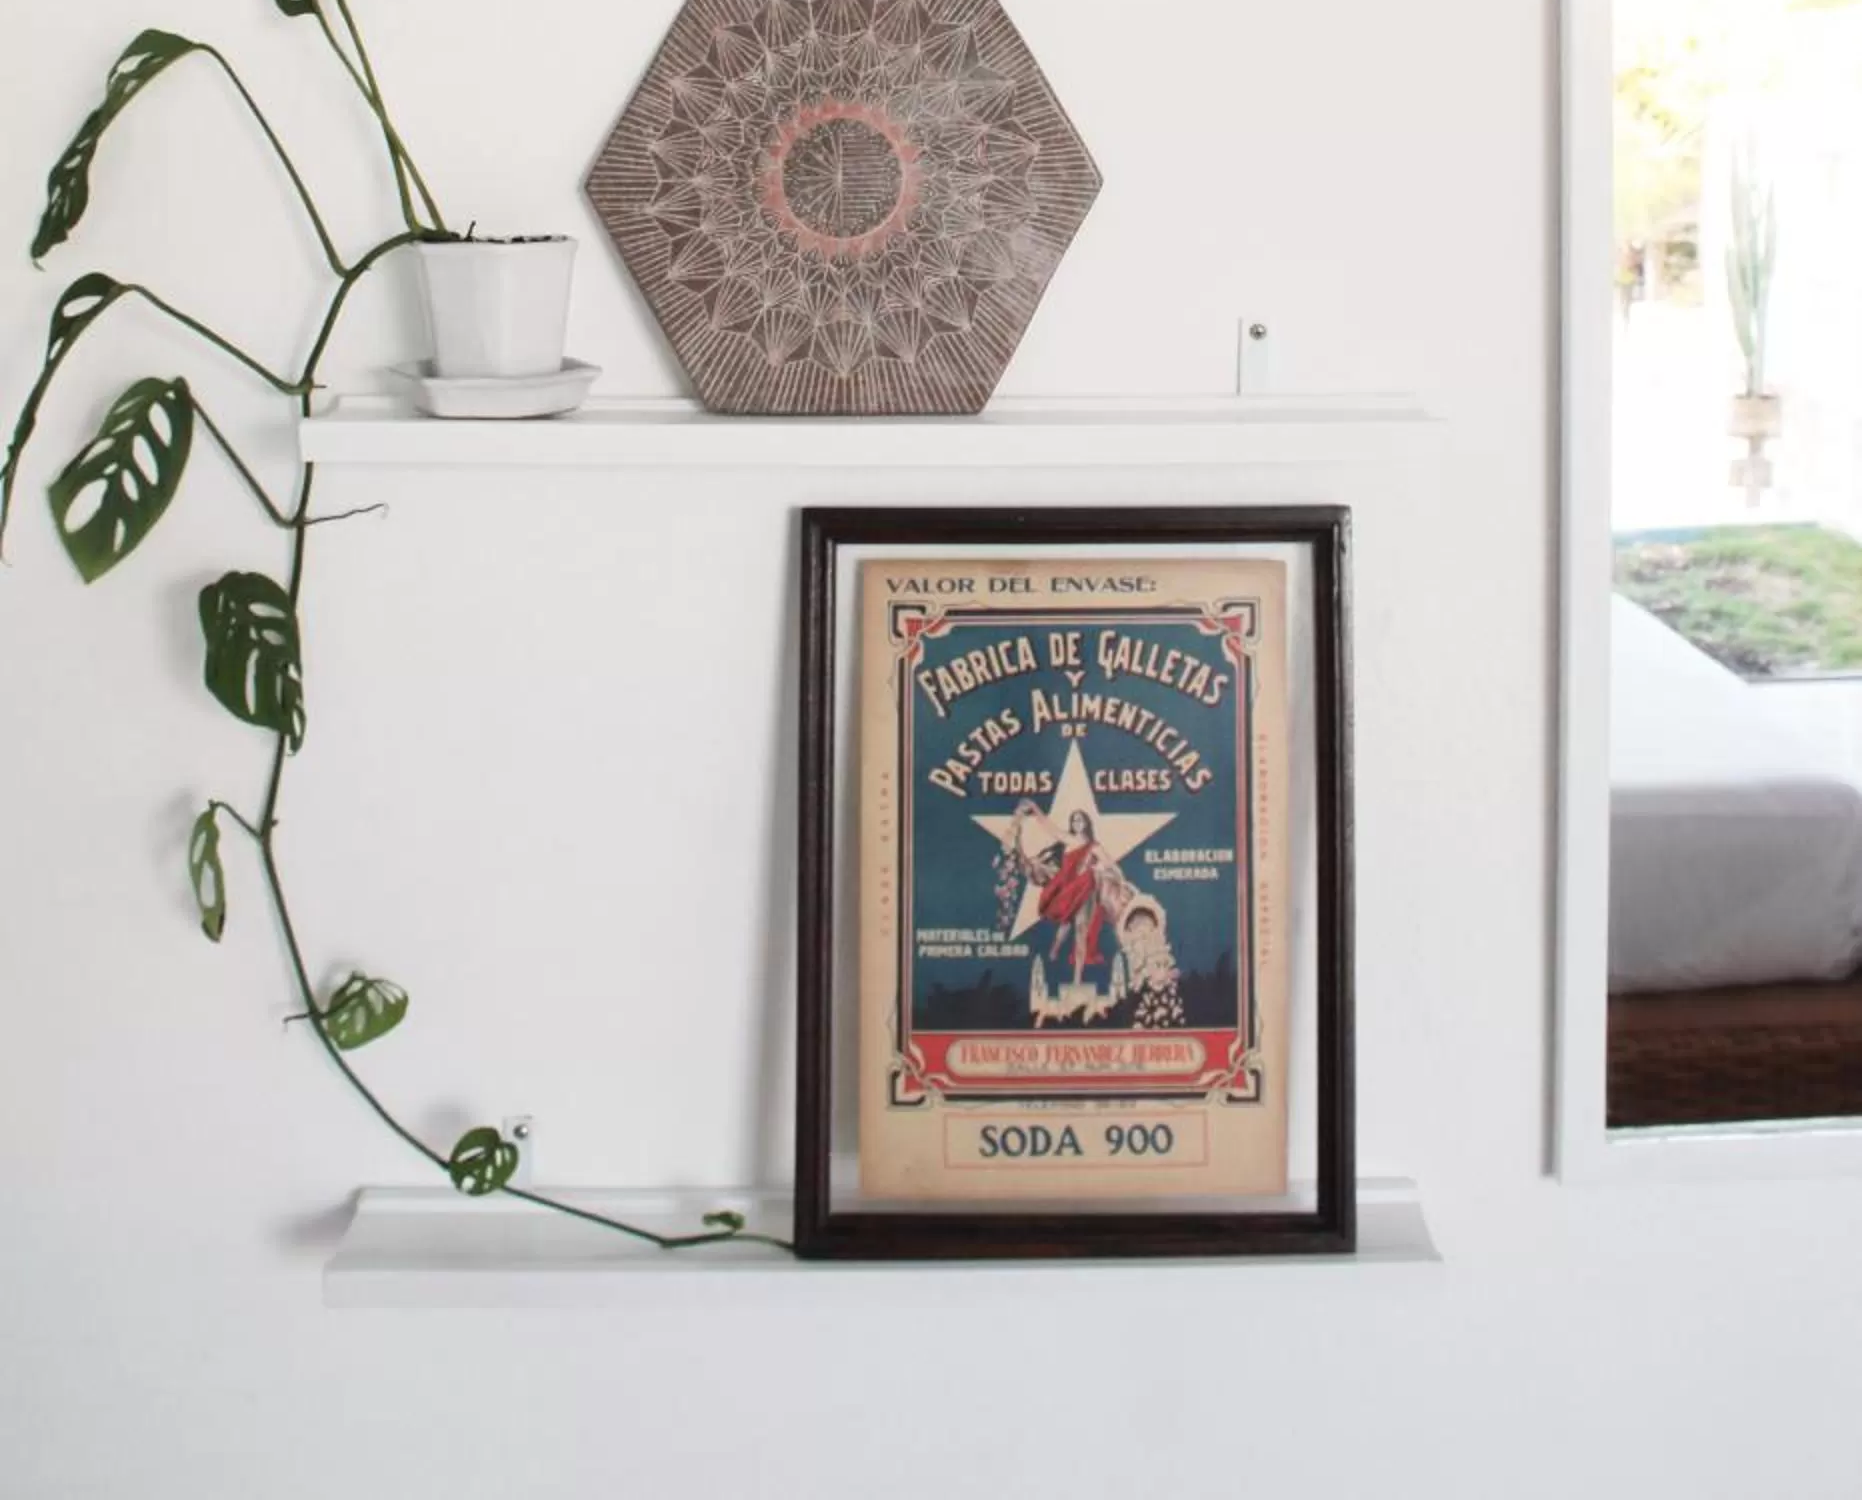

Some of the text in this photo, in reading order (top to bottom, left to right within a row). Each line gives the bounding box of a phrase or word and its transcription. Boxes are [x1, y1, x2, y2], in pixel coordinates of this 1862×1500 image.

[887, 576, 1157, 594] VALOR DEL ENVASE:
[917, 628, 1231, 719] FABRICA DE GALLETAS
[1064, 669, 1086, 689] Y
[1060, 722, 1088, 738] DE
[928, 688, 1214, 798] PASTAS ALIMENTICIAS
[978, 769, 1172, 793] TODAS CLASES
[1144, 849, 1233, 863] ELABORACION
[1153, 867, 1219, 881] ESMERADA
[916, 928, 990, 942] MATERIALES
[918, 944, 1030, 957] PRIMERA CALIDAD
[979, 1123, 1174, 1158] SODA 900
